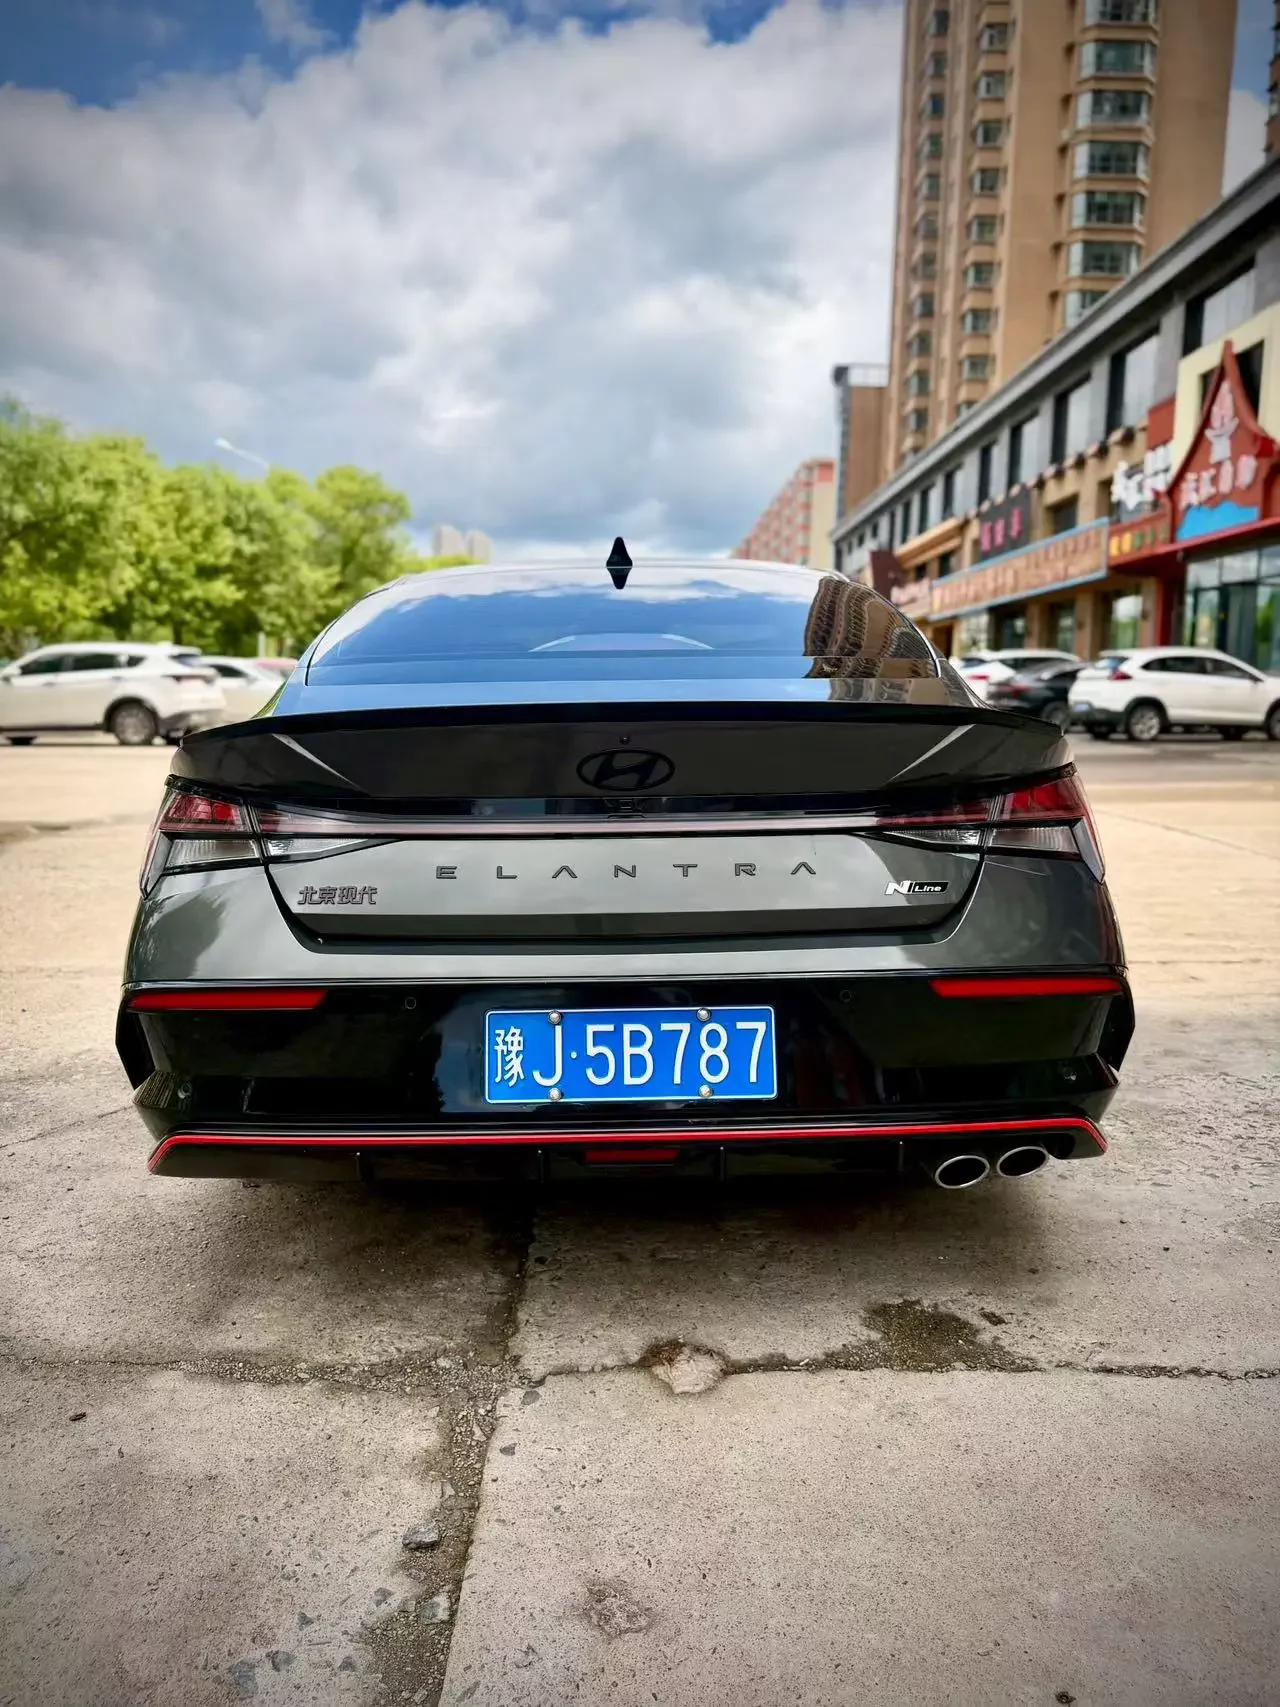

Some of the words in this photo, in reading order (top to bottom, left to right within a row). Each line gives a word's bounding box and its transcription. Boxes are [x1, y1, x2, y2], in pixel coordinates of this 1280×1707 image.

[435, 861, 816, 880] ELANTRA
[297, 885, 378, 905] 北京现代
